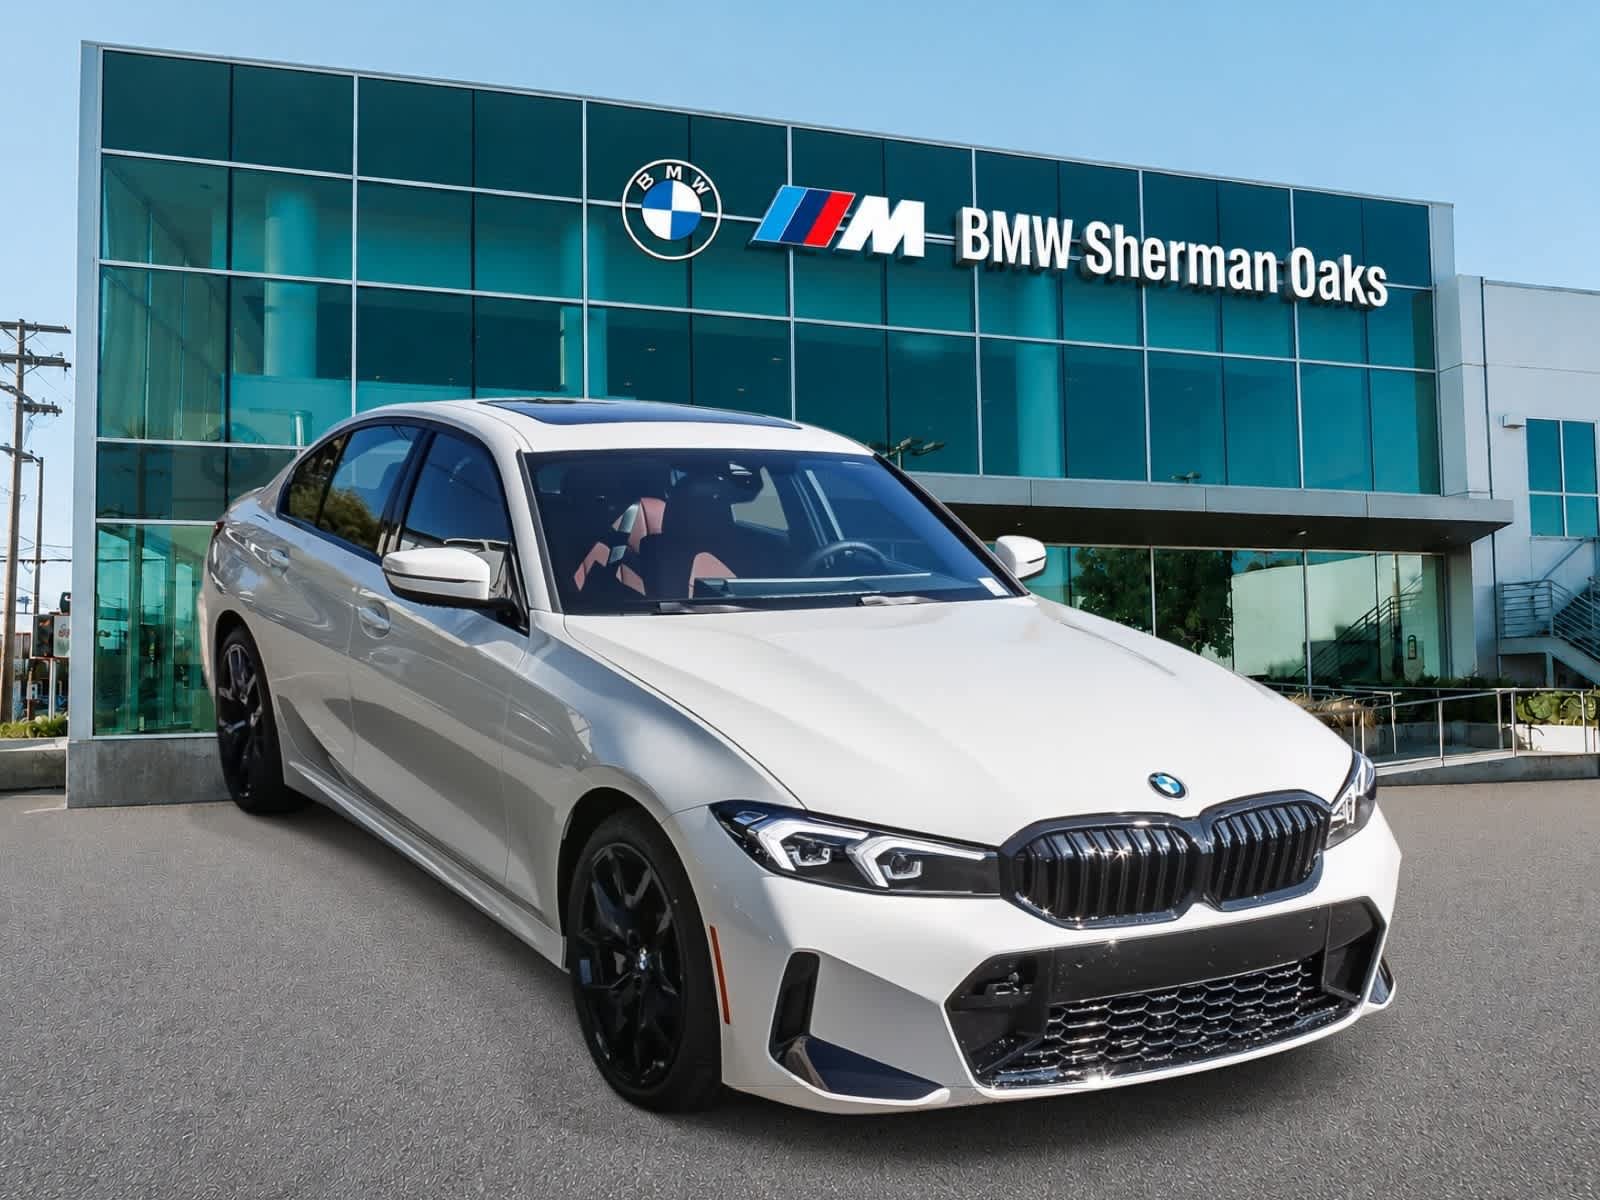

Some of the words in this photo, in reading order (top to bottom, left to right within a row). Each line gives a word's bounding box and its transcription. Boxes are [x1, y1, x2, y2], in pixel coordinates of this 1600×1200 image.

[636, 165, 711, 191] BMW
[959, 206, 1073, 270] BMW
[1084, 221, 1278, 293] Sherman
[1289, 247, 1388, 307] Oaks
